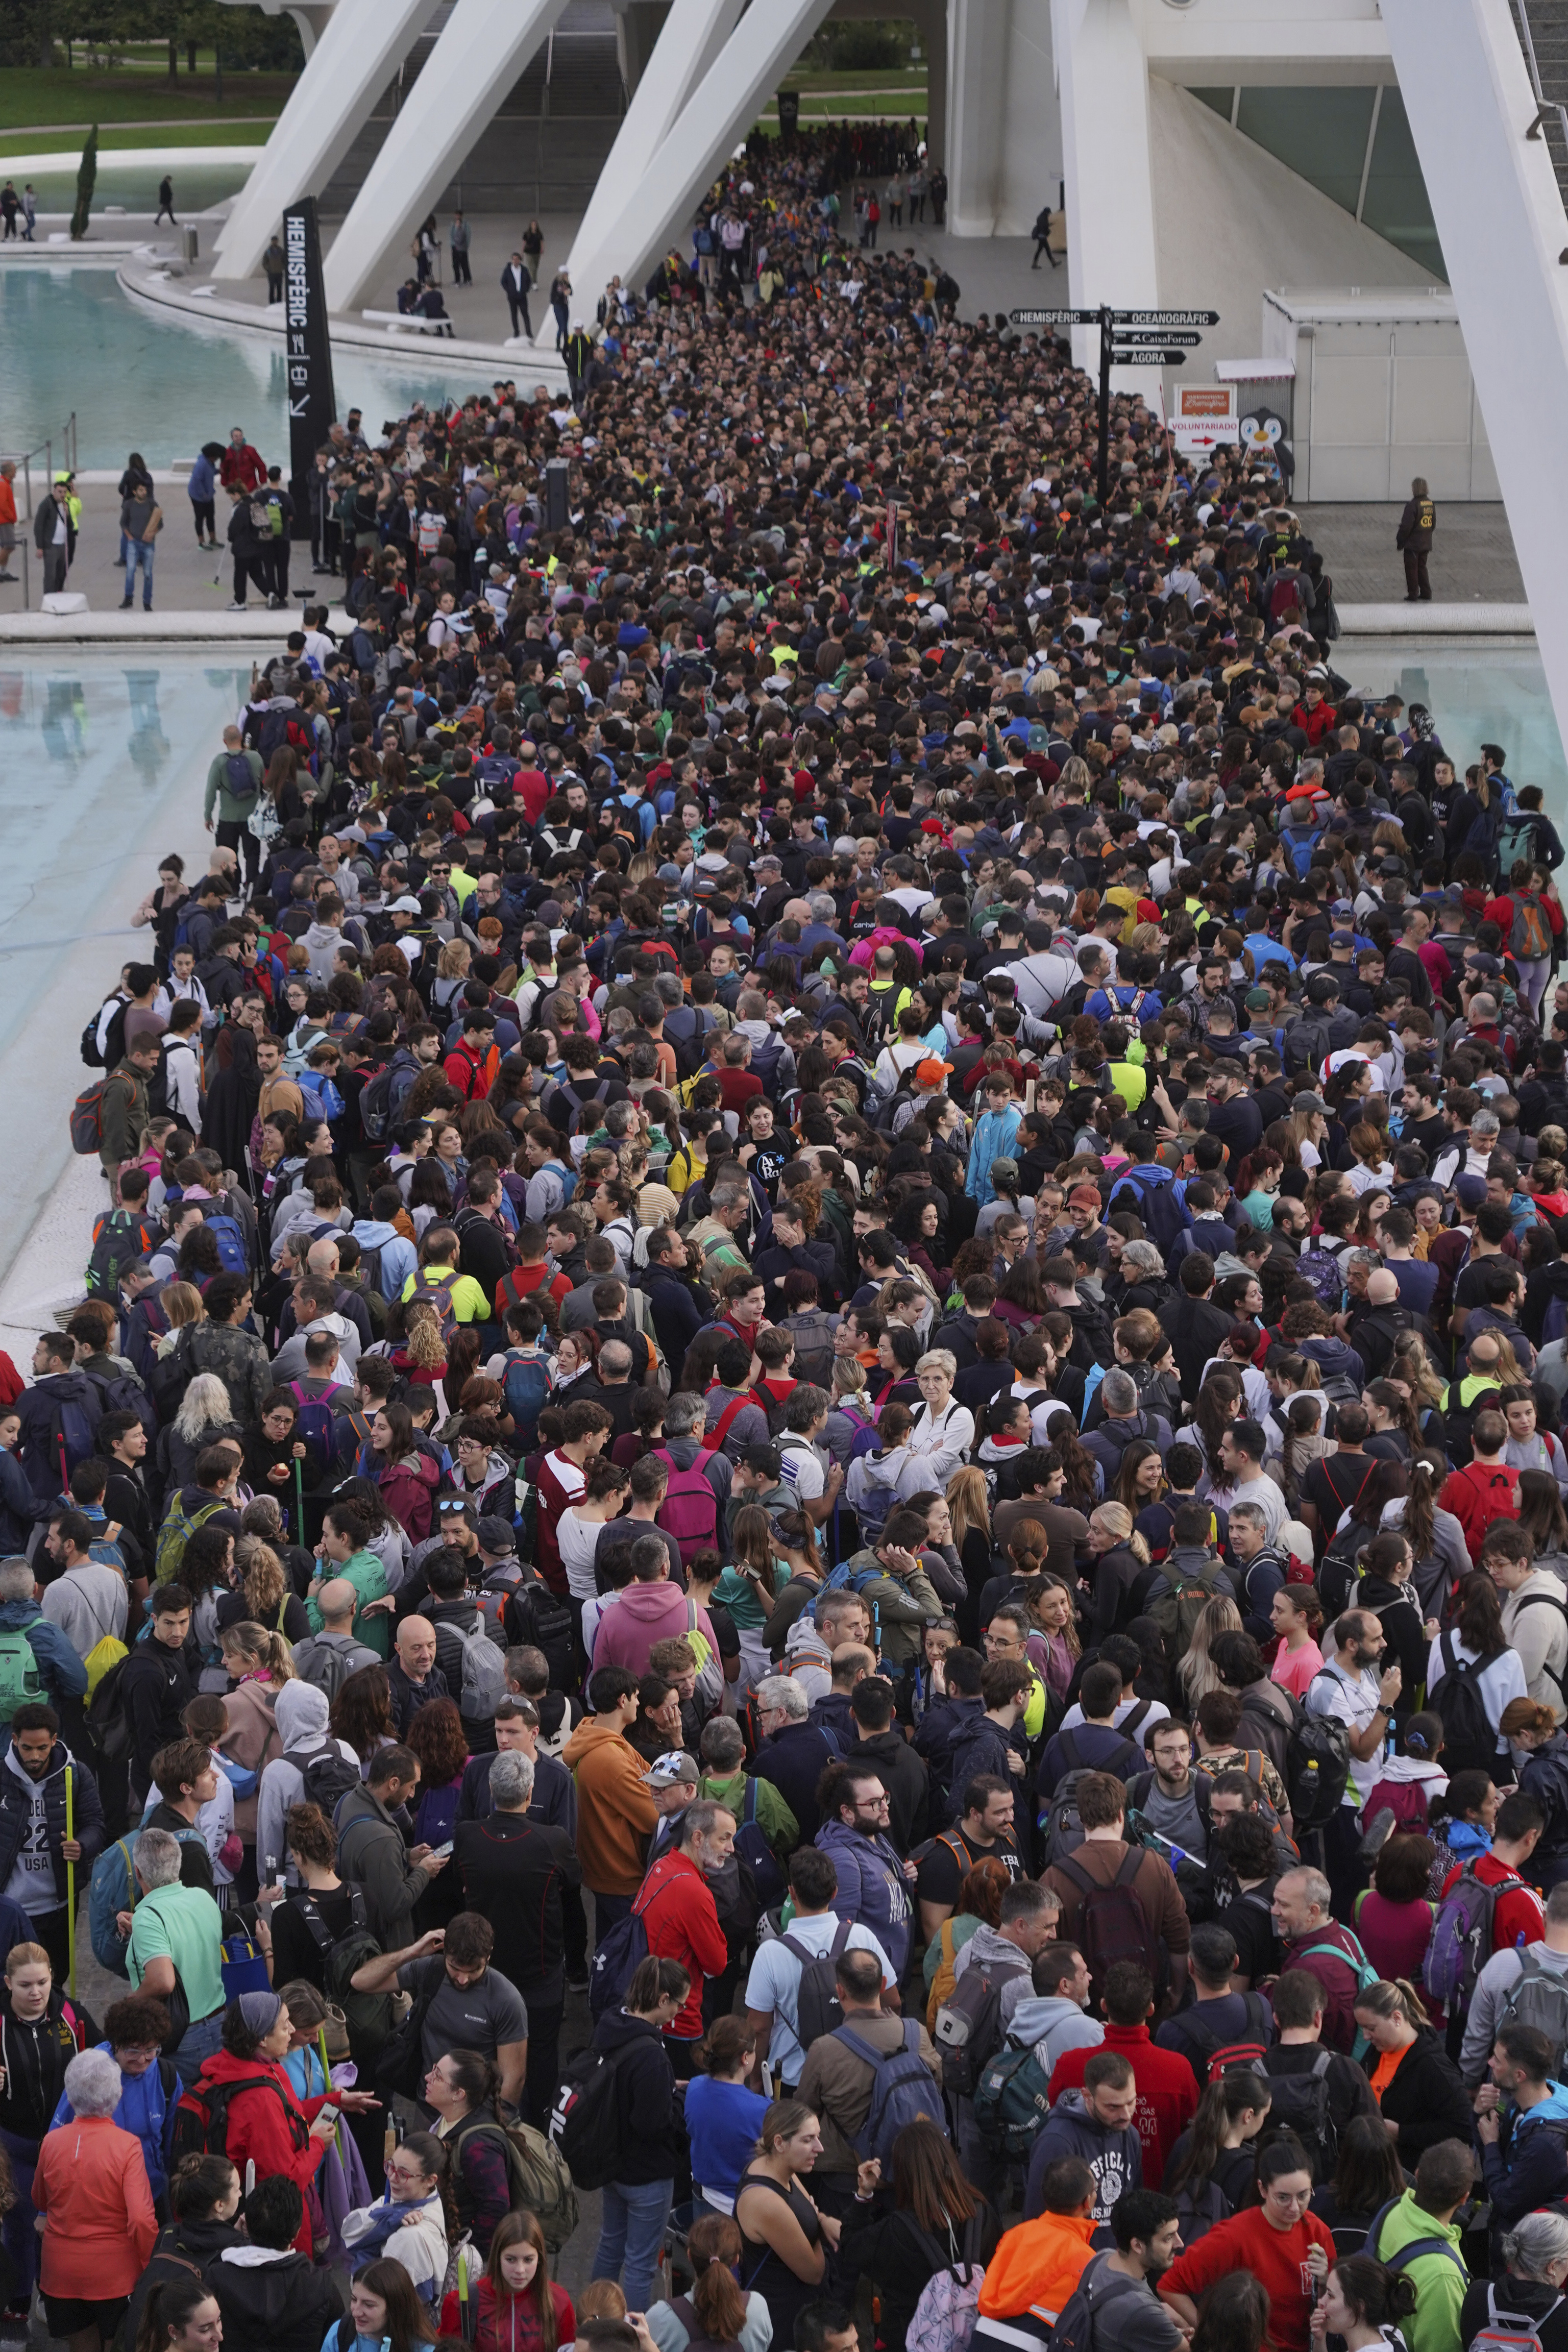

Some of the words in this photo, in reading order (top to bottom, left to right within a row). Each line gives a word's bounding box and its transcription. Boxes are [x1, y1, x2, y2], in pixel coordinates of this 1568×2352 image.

[287, 216, 307, 328] HEMISFÈRIC
[1020, 309, 1081, 323] HEMISFÈRIC
[1132, 310, 1209, 324] OCEANOGRÀFIC
[1142, 333, 1196, 344] CaixaForum
[1131, 351, 1166, 363] ÀGORA
[1172, 422, 1237, 431] VOLUNTARIADO
[107, 1256, 118, 1291] silver
[19, 1823, 50, 1853] 22
[25, 1856, 49, 1871] USA
[1136, 2095, 1147, 2106] CIÓ
[1140, 2107, 1155, 2116] GAS
